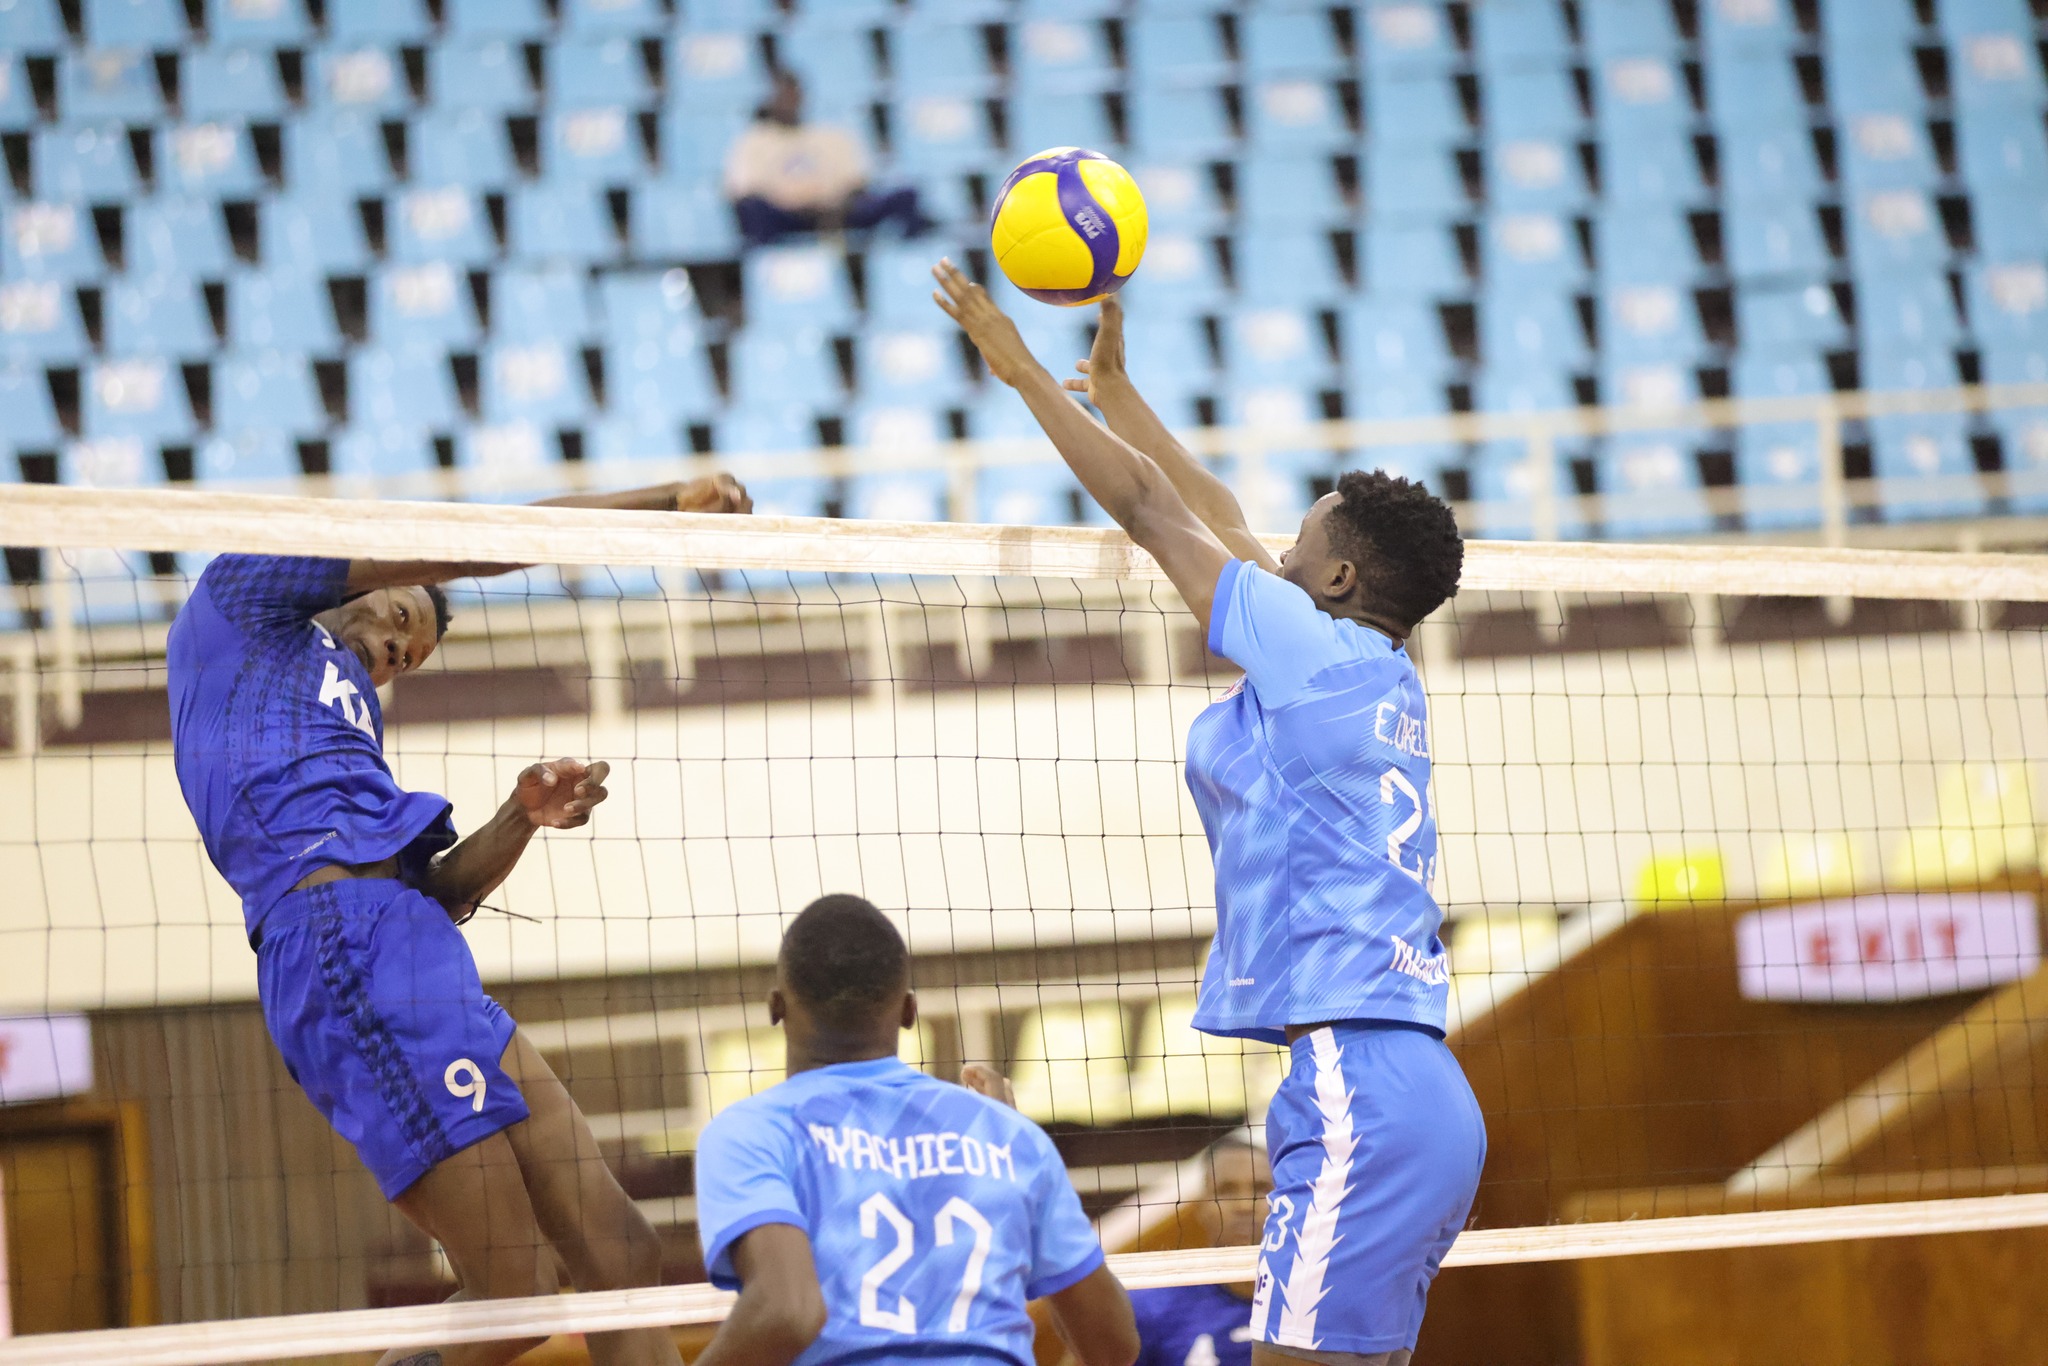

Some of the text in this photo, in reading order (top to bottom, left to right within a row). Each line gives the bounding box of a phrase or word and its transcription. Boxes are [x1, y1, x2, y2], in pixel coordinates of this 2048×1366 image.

[1807, 917, 1964, 972] EXIT
[444, 1058, 487, 1112] 9
[859, 1191, 994, 1335] 27
